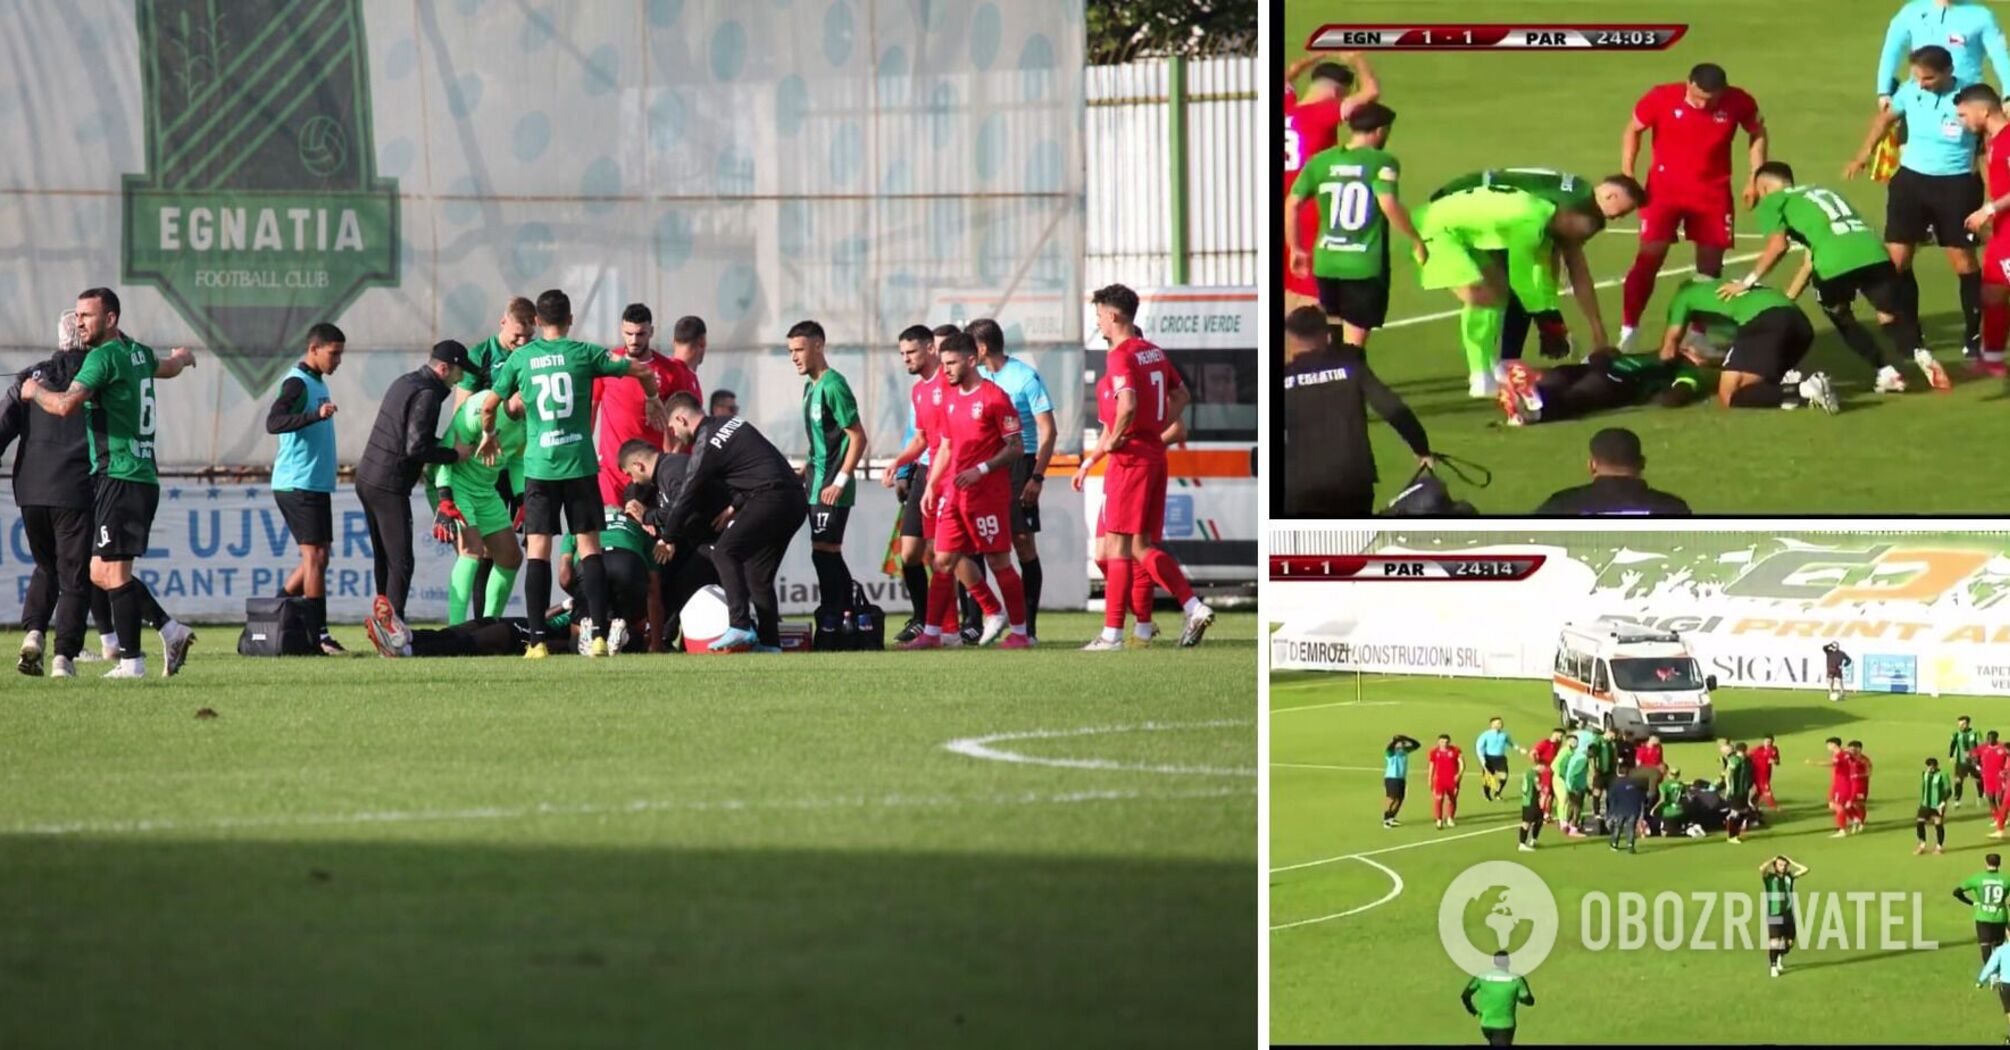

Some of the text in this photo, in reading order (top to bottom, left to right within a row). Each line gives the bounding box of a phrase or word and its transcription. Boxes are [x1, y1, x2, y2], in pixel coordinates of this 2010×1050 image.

[1318, 181, 1369, 230] 10
[159, 206, 364, 252] EGNATIA
[195, 270, 329, 289] FOOTBALL CLUB
[1160, 315, 1200, 333] CROCE
[1203, 314, 1242, 333] VERDE
[530, 353, 565, 370] MUSTA
[139, 377, 155, 435] 6
[530, 371, 574, 421] 29
[1150, 370, 1165, 421] 7
[816, 512, 830, 528] 17
[976, 515, 999, 537] 99
[1730, 618, 1933, 641] PRINT
[1290, 642, 1349, 663] DEMROZI
[1457, 648, 1481, 668] SRL
[1984, 886, 2003, 904] 19
